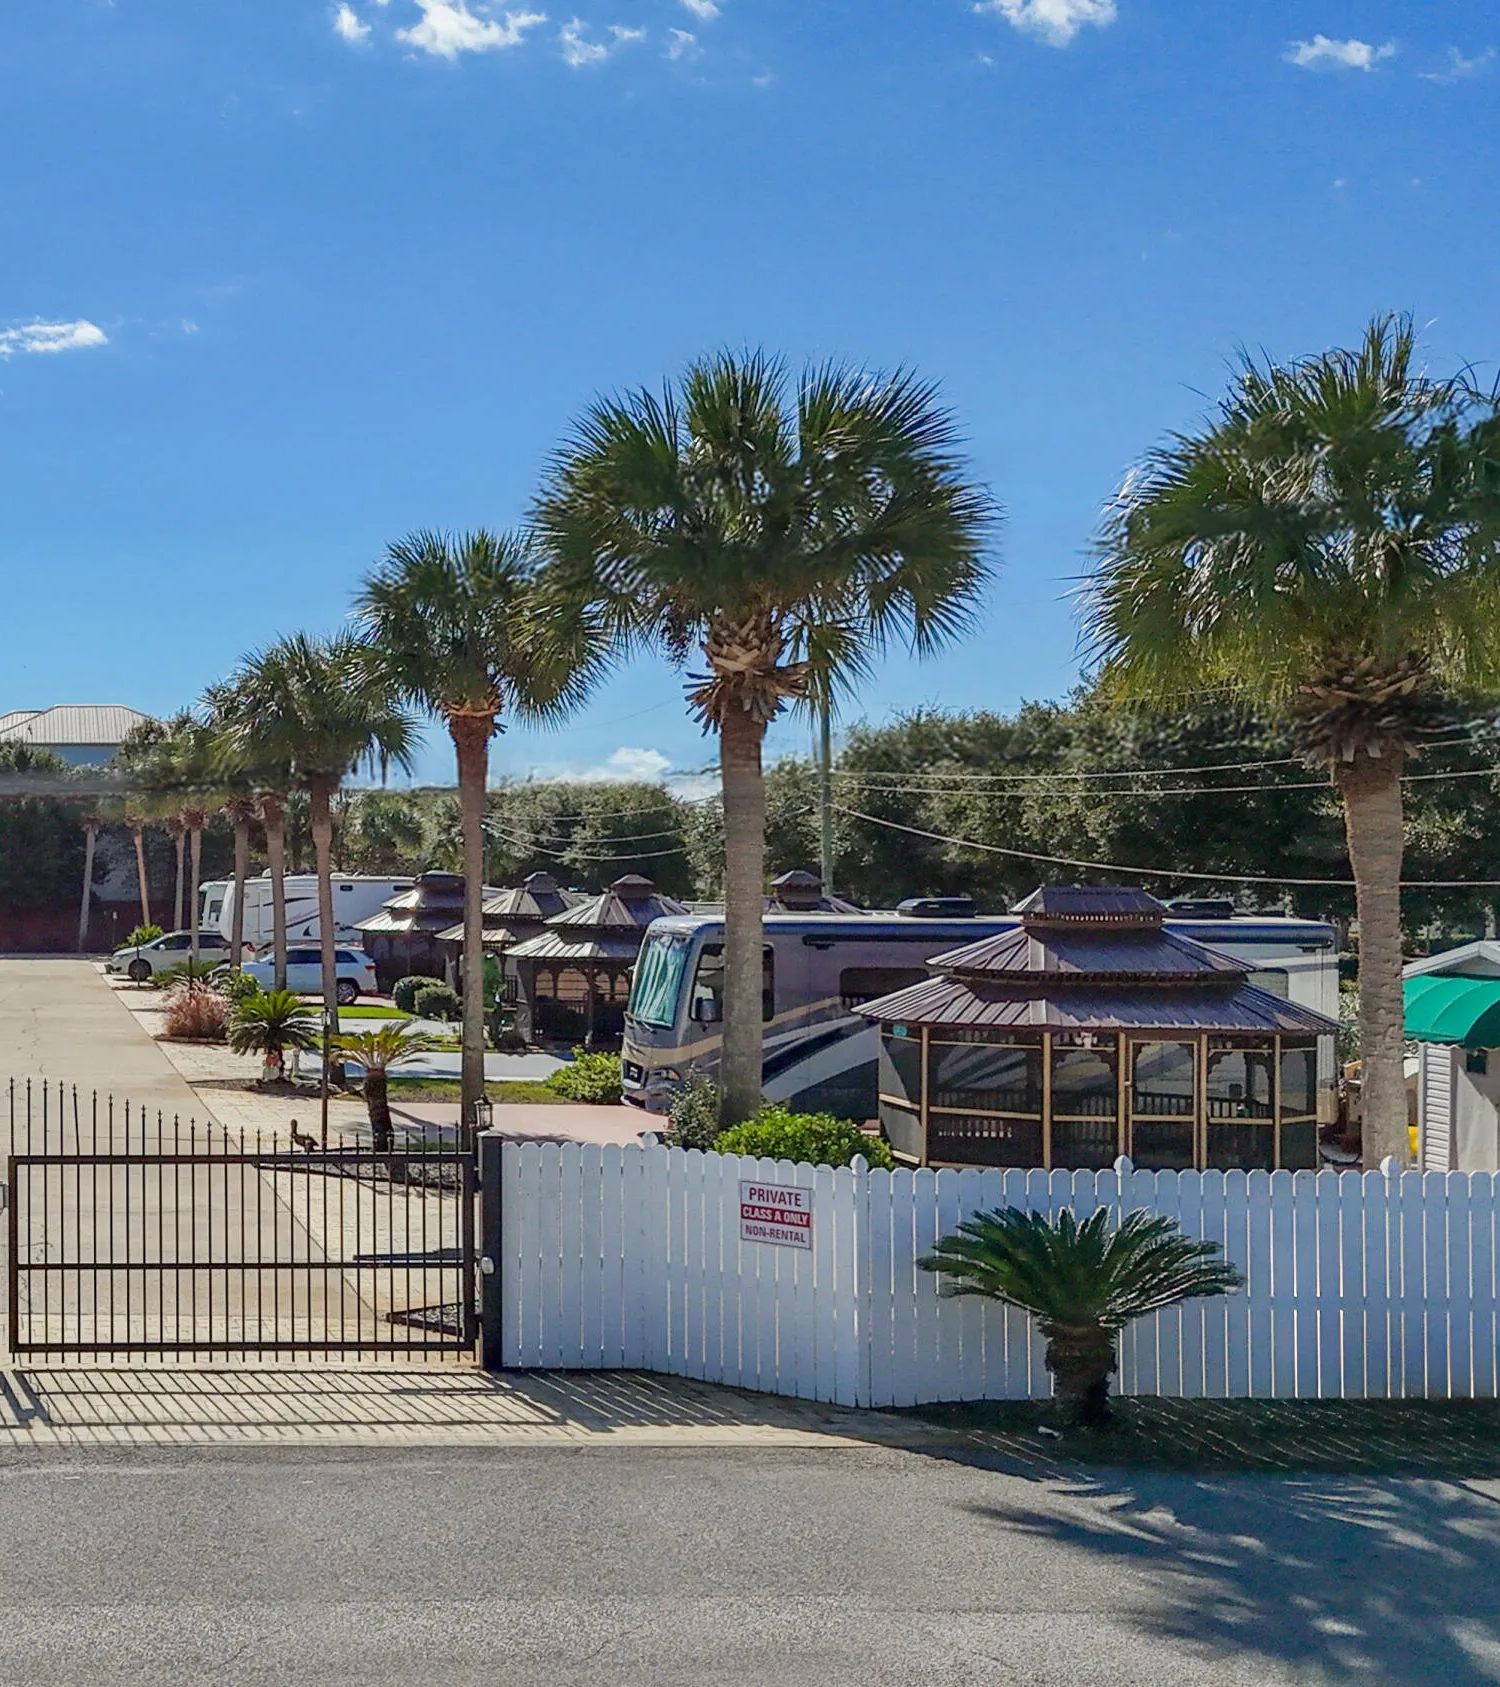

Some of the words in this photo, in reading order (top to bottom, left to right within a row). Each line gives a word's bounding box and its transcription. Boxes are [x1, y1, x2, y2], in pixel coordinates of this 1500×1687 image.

[749, 1187, 802, 1207] PRIVATE
[743, 1207, 772, 1221] CLASS
[774, 1211, 782, 1222] A
[784, 1212, 808, 1225] ONLY
[745, 1224, 806, 1243] NON-RENTAL
